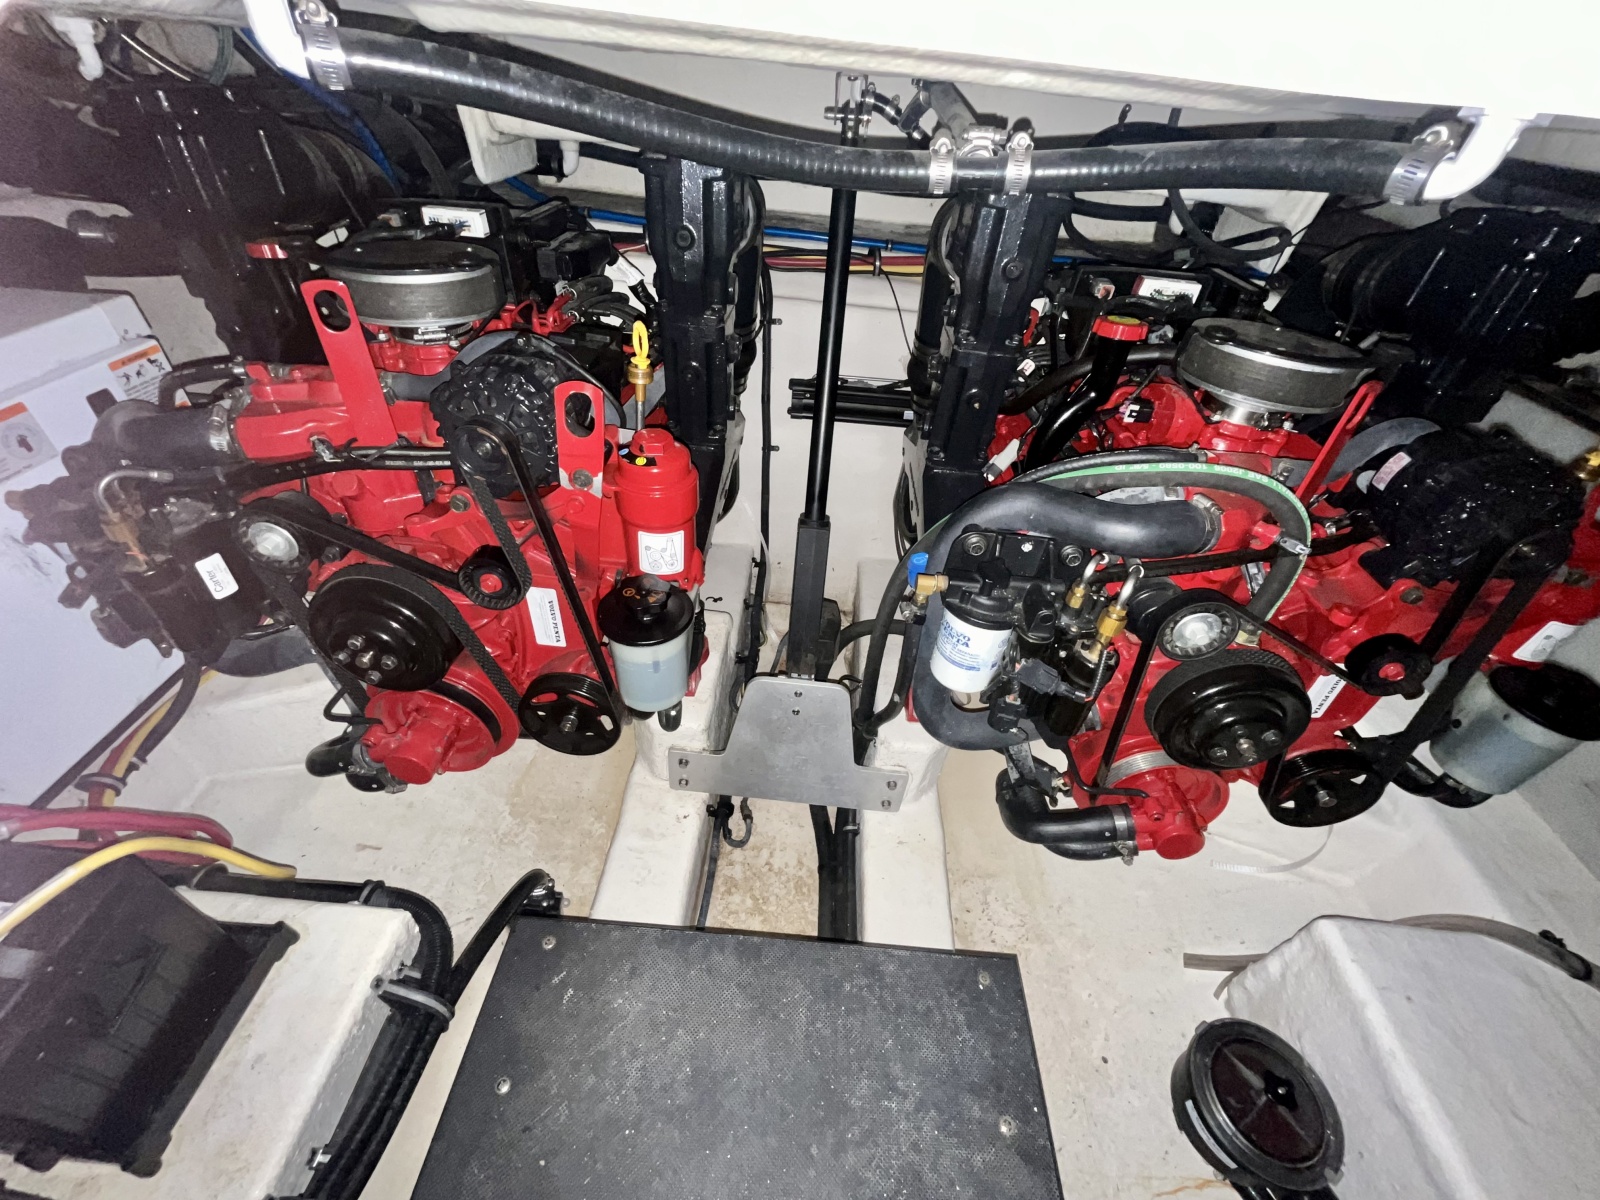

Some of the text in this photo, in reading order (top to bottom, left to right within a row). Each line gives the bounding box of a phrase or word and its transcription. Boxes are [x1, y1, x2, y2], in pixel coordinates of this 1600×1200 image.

[1247, 471, 1269, 483] SAE
[206, 569, 224, 593] Carter
[548, 600, 561, 643] VOLVO PENTA
[941, 619, 971, 642] VOLVO
[1312, 695, 1330, 714] PENTA
